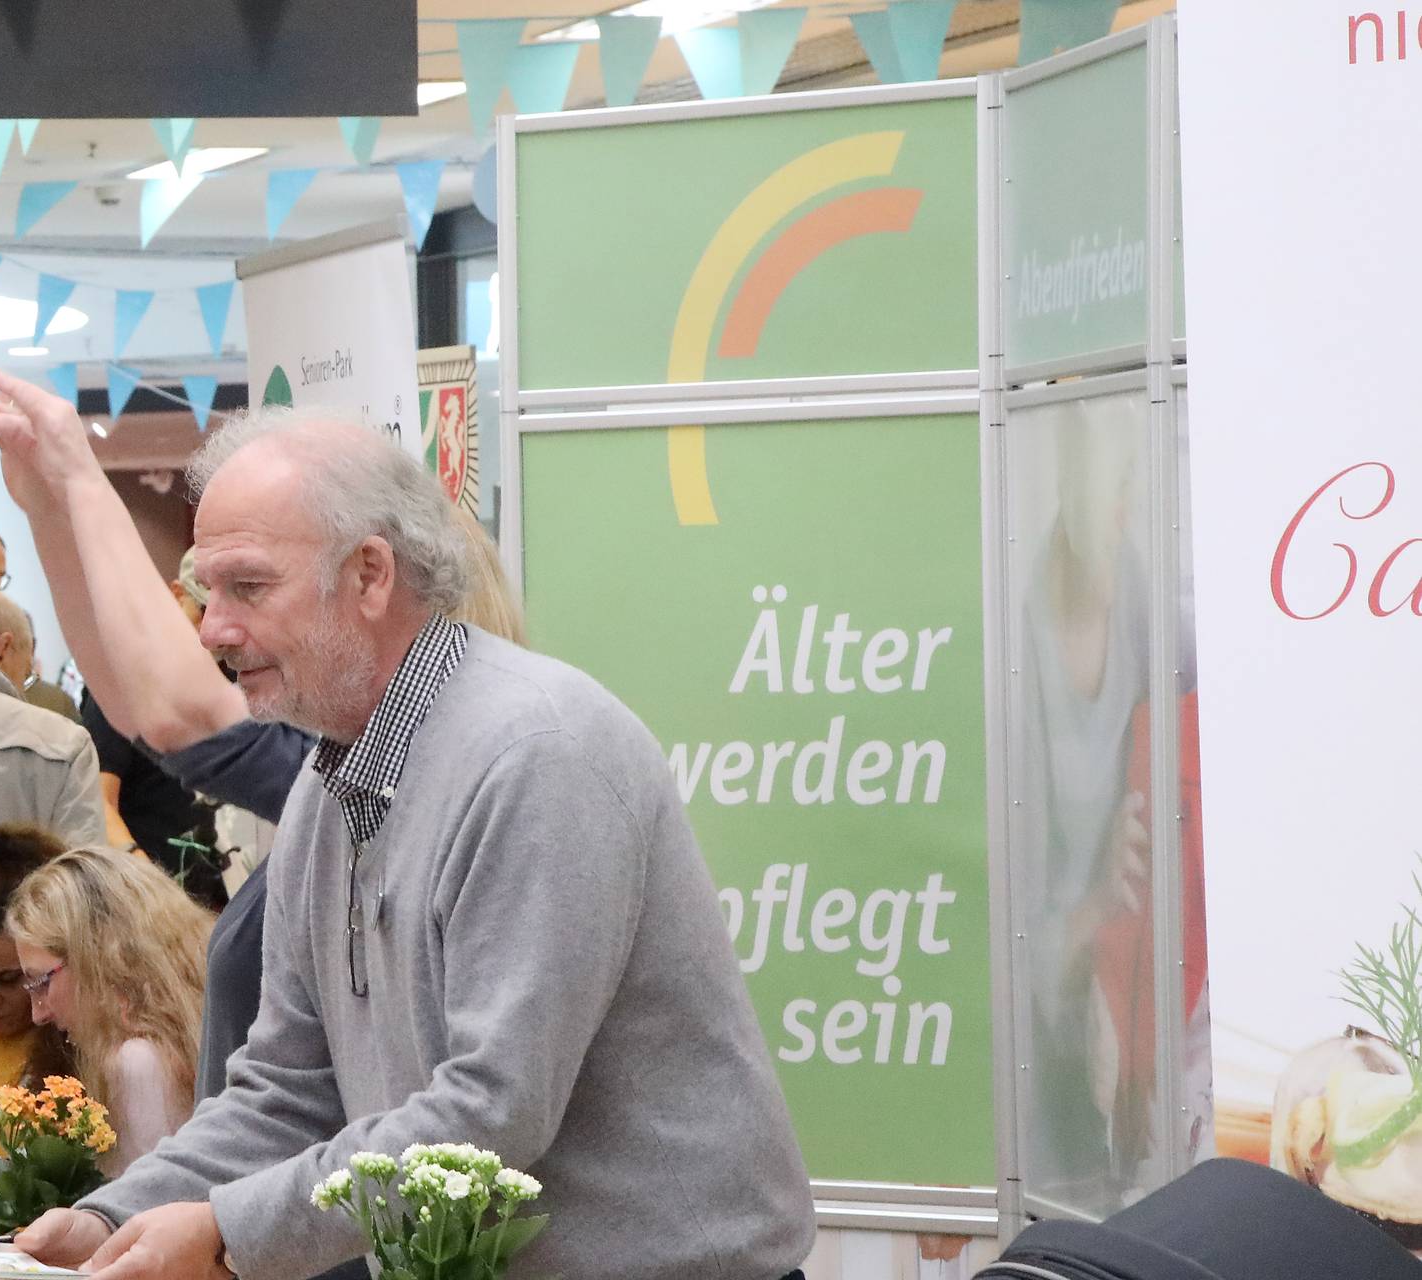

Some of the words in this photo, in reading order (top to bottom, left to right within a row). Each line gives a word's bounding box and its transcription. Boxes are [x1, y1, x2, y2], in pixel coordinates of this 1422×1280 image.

[1348, 11, 1422, 64] ni
[1018, 226, 1145, 324] Abendfrieden
[301, 348, 353, 386] Senioren-Park
[729, 584, 953, 693] Älter
[778, 976, 953, 1065] sein
